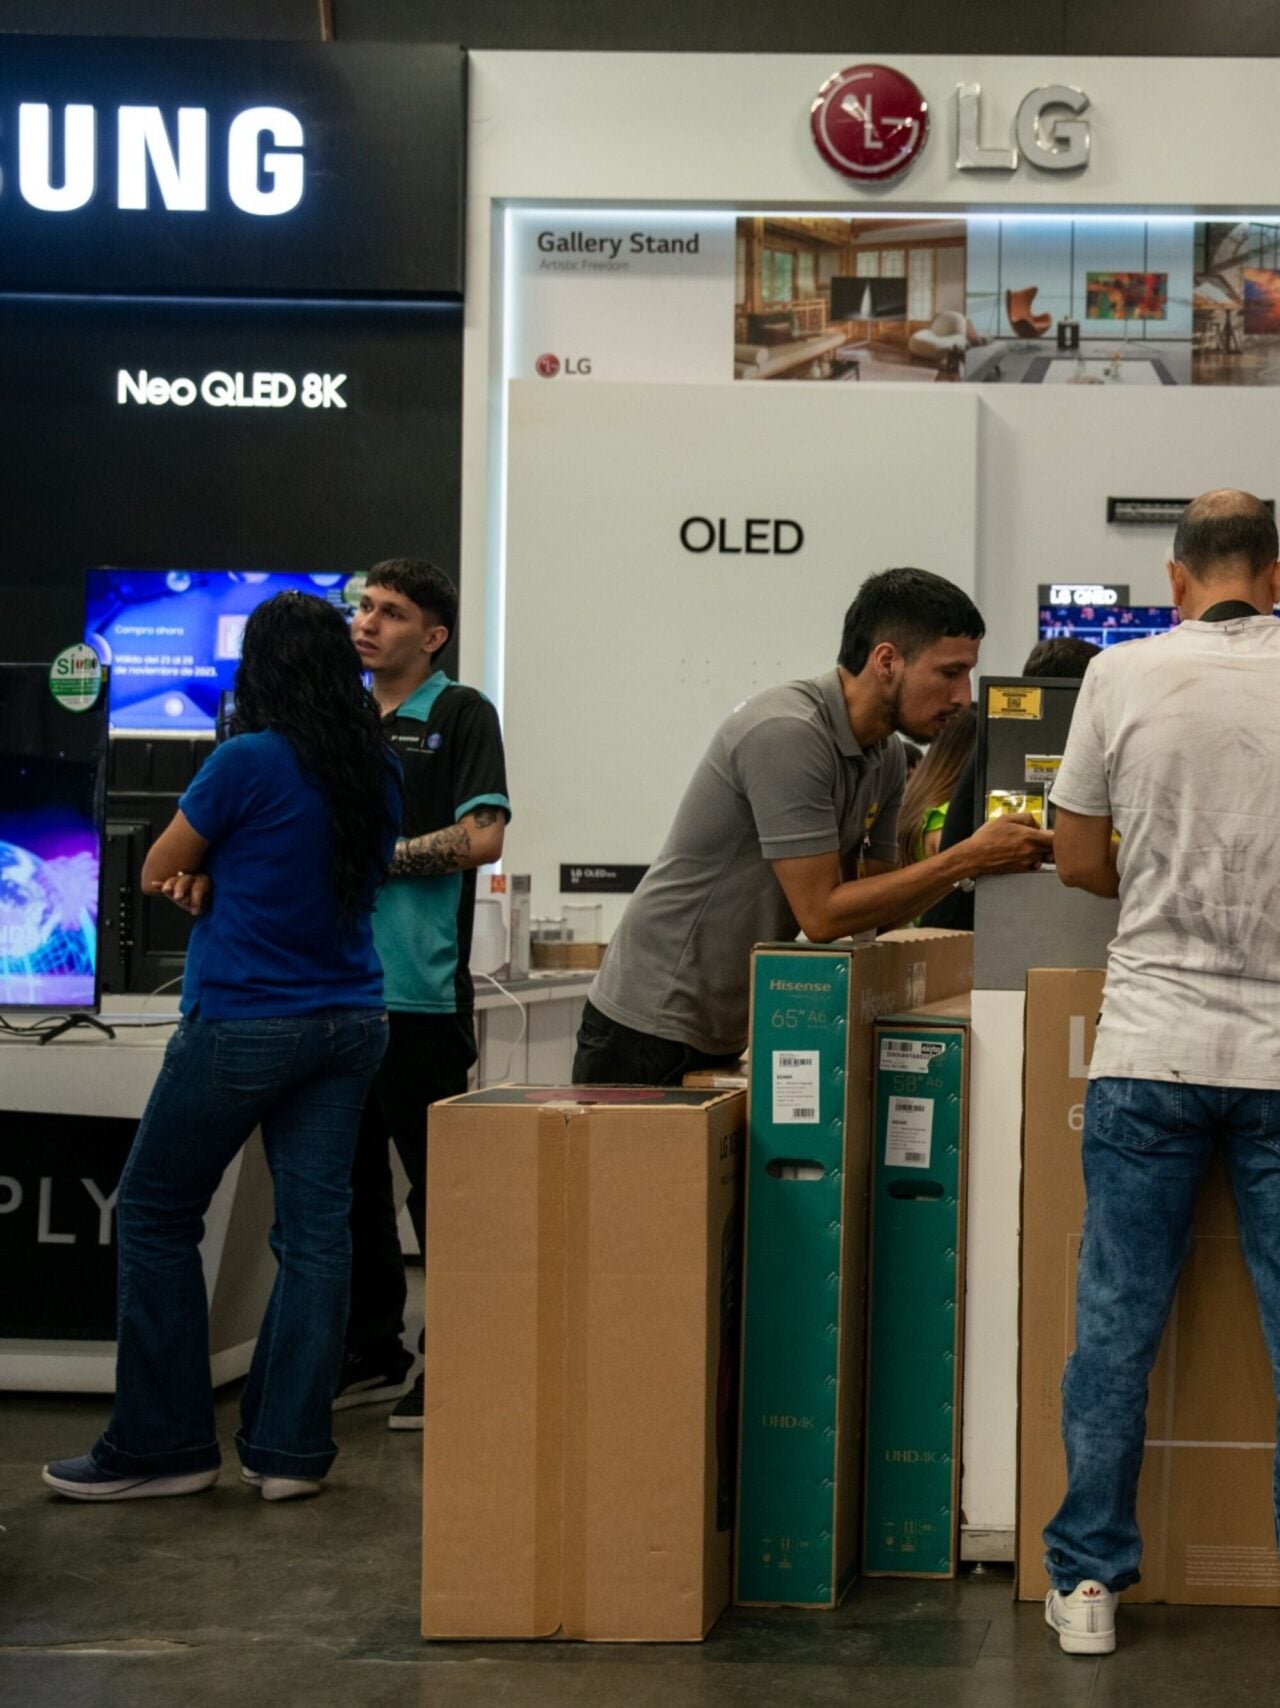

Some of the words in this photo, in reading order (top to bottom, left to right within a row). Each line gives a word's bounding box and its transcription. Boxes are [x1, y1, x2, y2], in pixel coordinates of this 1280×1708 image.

[956, 82, 1090, 170] LG
[0, 103, 305, 215] UNG
[537, 231, 622, 259] Gallery
[630, 232, 699, 254] Stand
[539, 259, 577, 271] Artistic
[581, 260, 630, 271] Freedom
[565, 357, 592, 375] LG
[117, 369, 198, 406] Neo
[201, 370, 297, 407] QLED
[301, 372, 348, 408] 8K
[680, 518, 804, 555] OLED
[156, 625, 184, 635] ahora
[769, 979, 832, 991] Hisense
